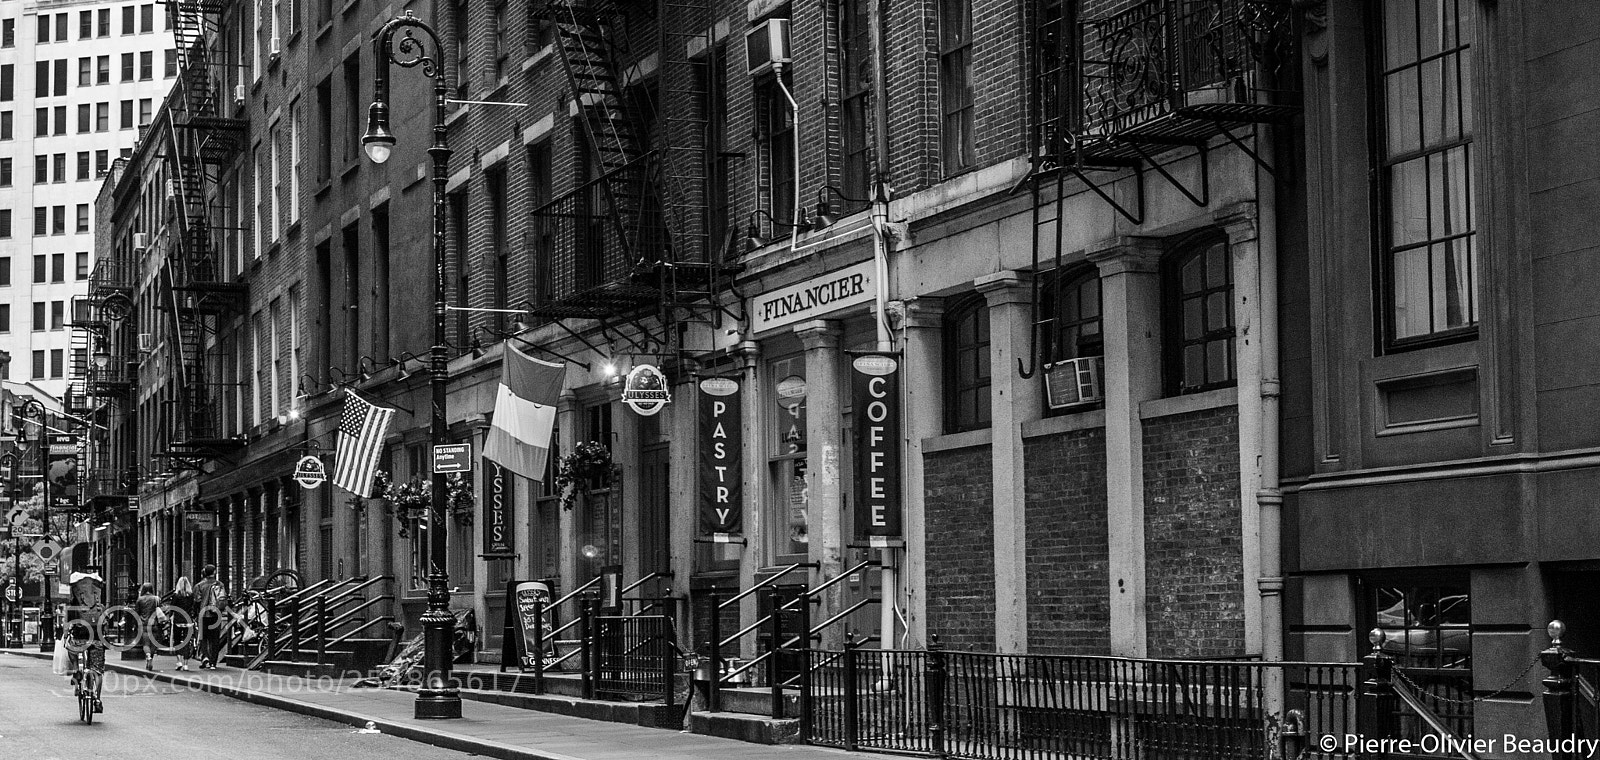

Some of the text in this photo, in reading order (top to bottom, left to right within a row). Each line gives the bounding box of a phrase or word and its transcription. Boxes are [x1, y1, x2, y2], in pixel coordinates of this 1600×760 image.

[763, 273, 864, 322] FINANCIER
[627, 391, 665, 399] ULYSSES
[442, 446, 465, 454] STANDING
[712, 401, 730, 525] PASTRY
[866, 377, 888, 527] COFFEE
